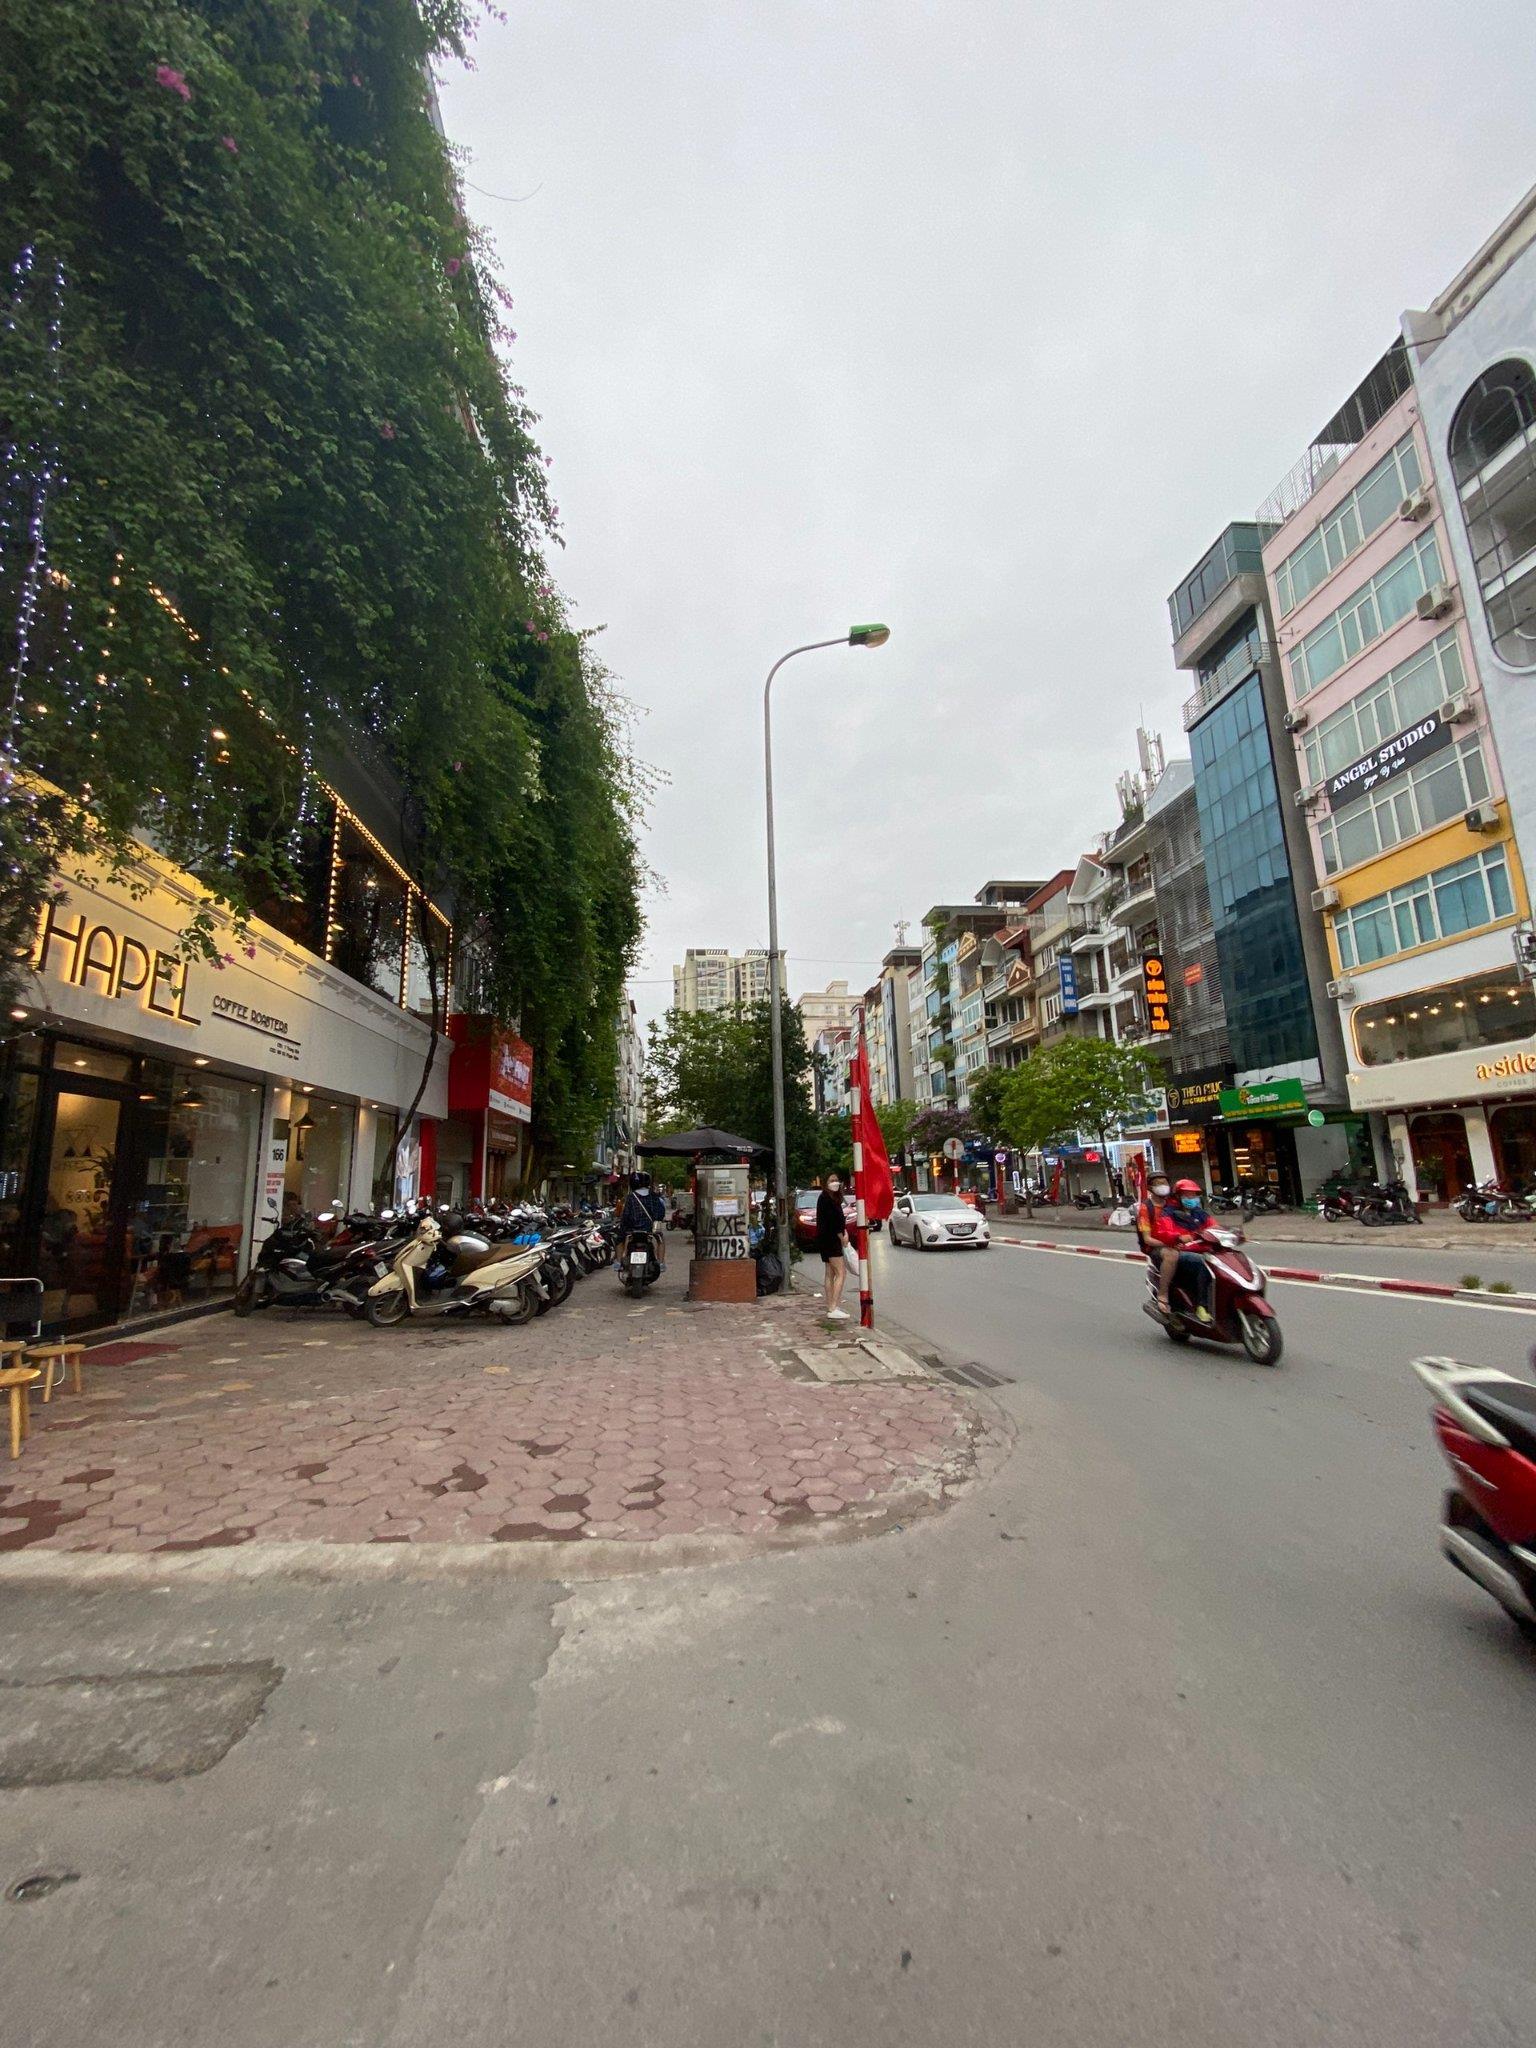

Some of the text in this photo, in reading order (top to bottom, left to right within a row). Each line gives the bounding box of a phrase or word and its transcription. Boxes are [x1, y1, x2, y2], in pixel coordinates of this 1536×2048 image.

[1333, 757, 1378, 793] ANGEL
[1379, 719, 1436, 764] STUDIO
[29, 902, 201, 1026] HAPEL
[213, 995, 249, 1019] COFFEE
[272, 1148, 285, 1162] 166
